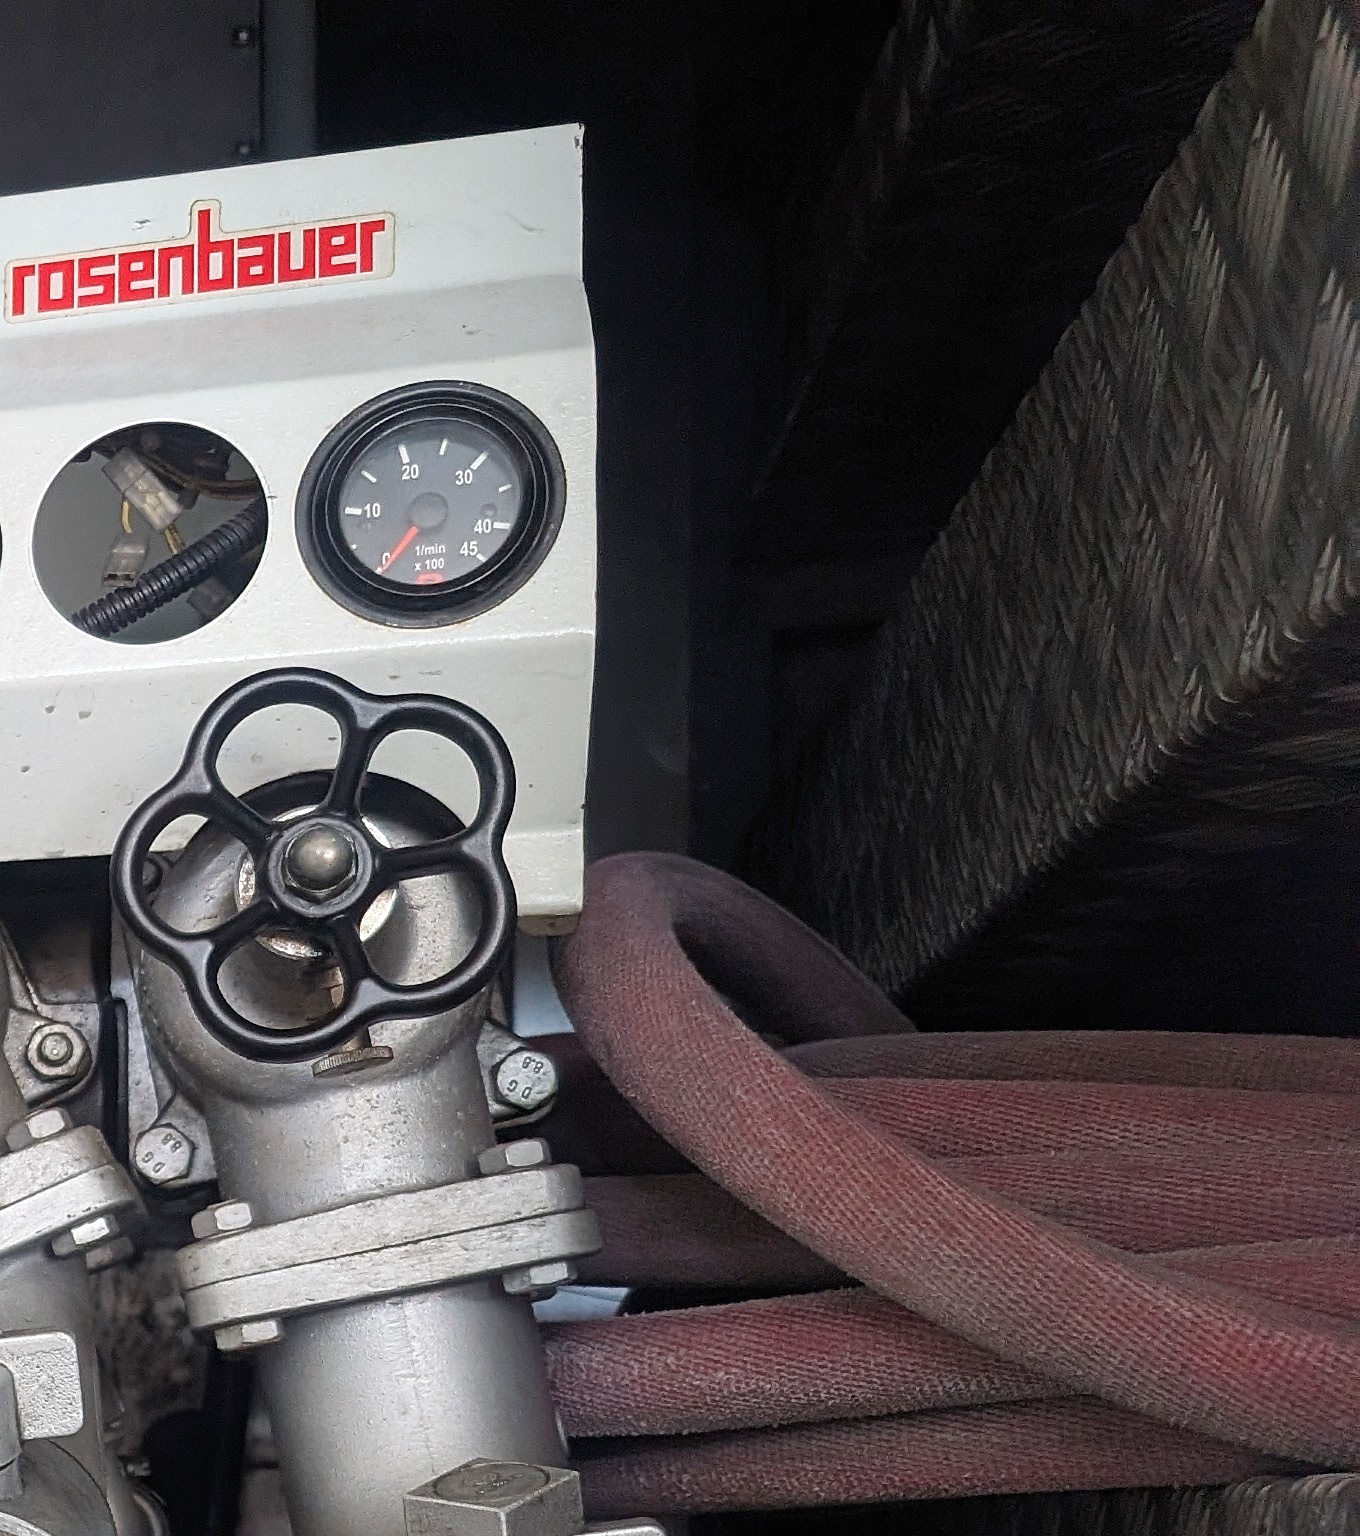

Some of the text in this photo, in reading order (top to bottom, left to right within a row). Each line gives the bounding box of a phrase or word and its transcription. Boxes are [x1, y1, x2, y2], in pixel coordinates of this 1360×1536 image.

[11, 208, 386, 316] rosenbauer
[401, 464, 419, 480] 20
[455, 470, 473, 485] 30
[363, 503, 381, 518] 10
[474, 518, 492, 534] 40
[415, 544, 446, 556] 1/min
[459, 541, 478, 557] 45
[424, 558, 445, 570] 100
